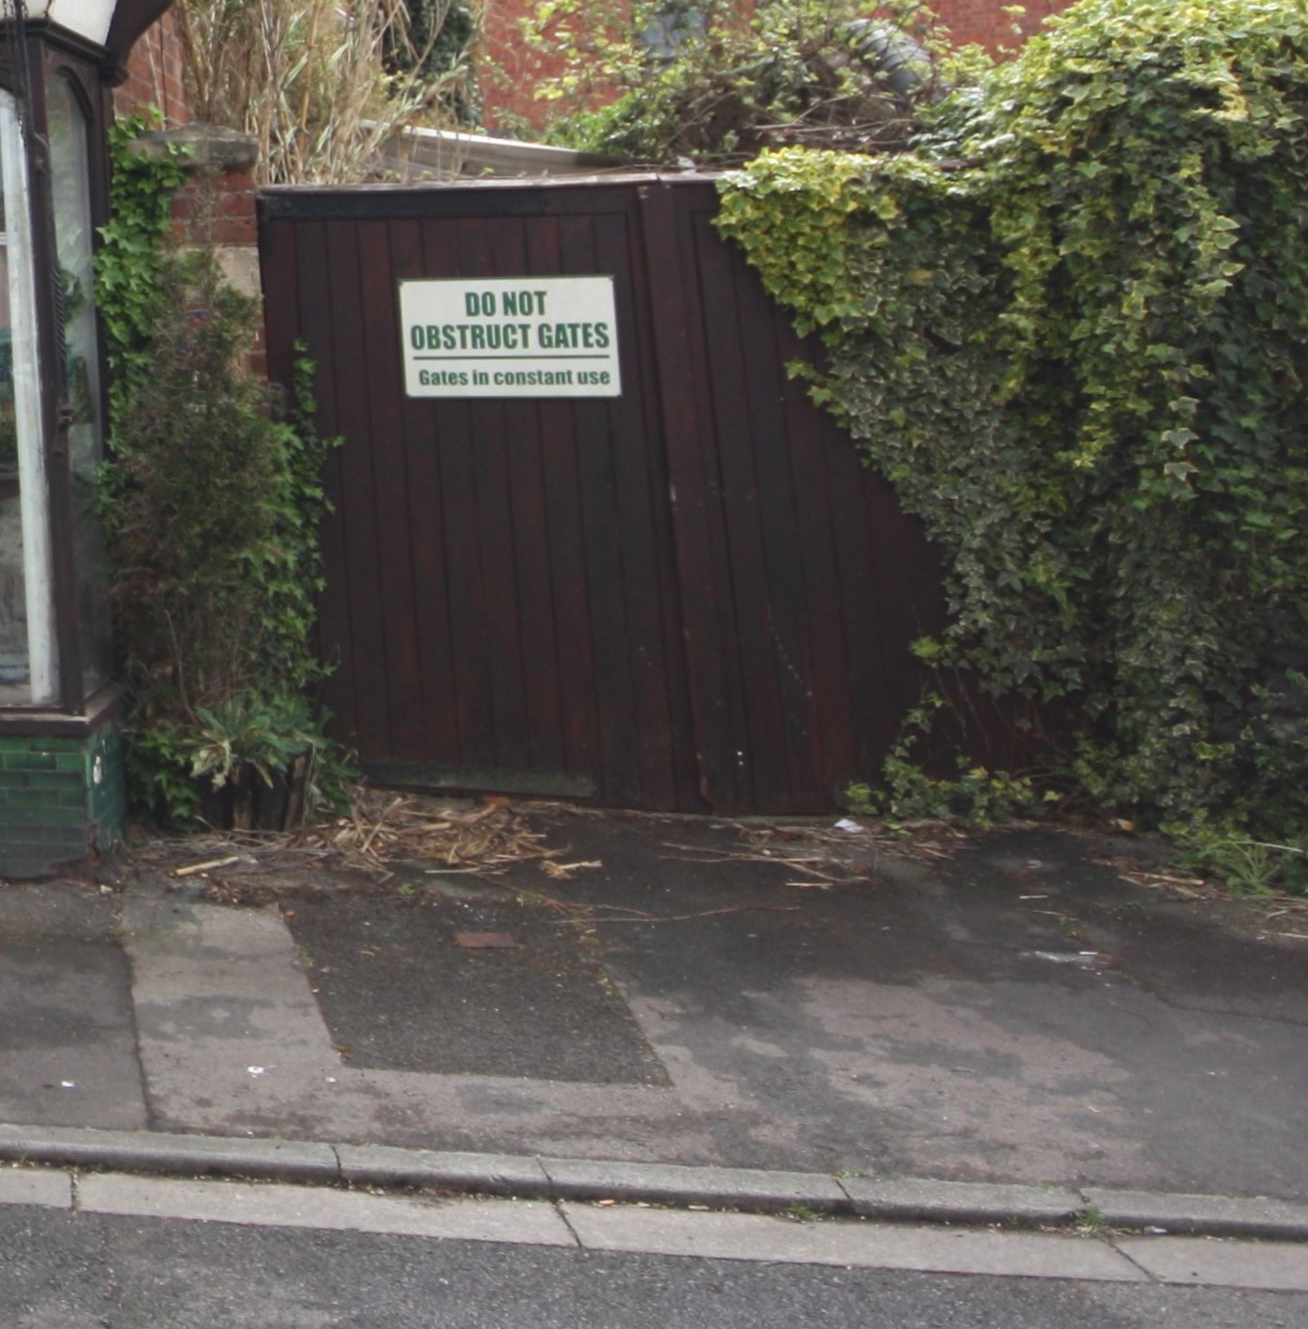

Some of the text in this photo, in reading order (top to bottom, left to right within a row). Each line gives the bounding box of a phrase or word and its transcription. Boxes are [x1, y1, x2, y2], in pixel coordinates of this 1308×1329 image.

[465, 291, 547, 317] DO NOT
[410, 322, 610, 350] OBSTRUCT GATES
[419, 369, 610, 386] Gates in constant use
